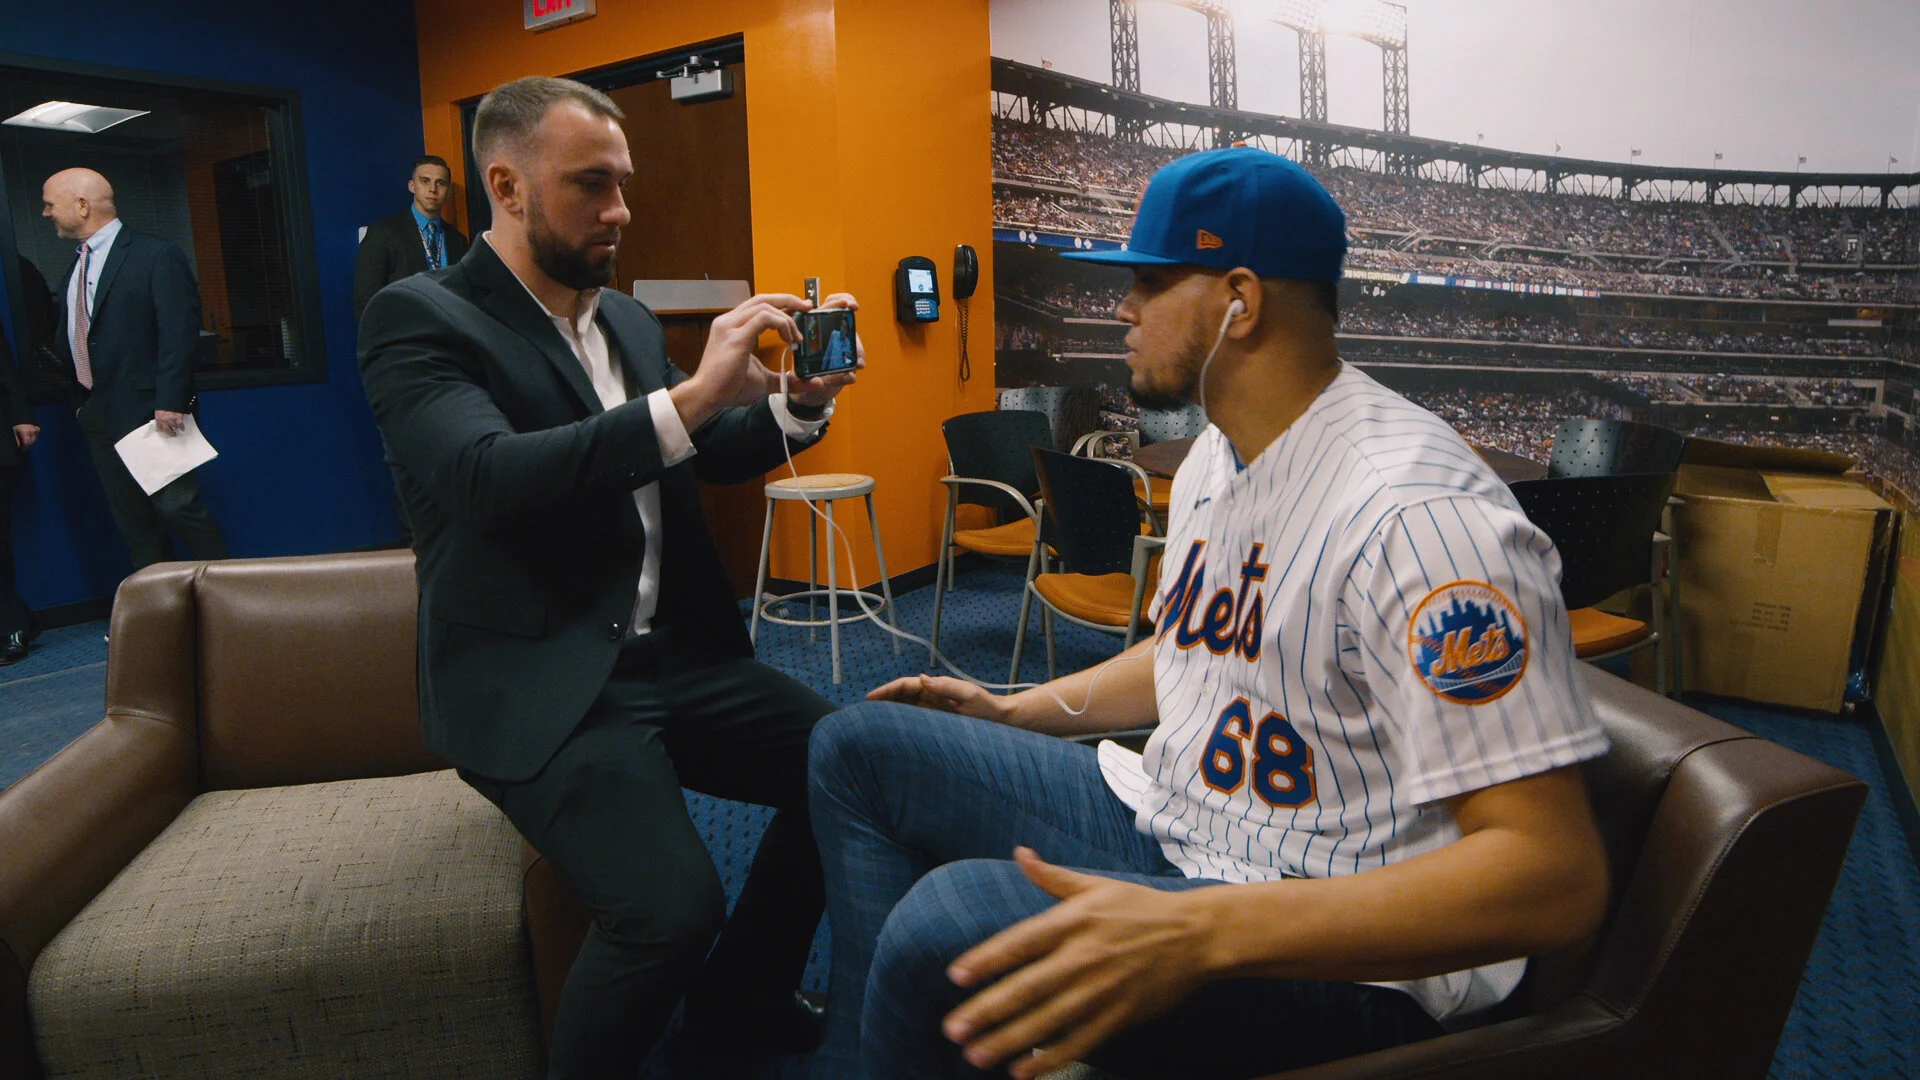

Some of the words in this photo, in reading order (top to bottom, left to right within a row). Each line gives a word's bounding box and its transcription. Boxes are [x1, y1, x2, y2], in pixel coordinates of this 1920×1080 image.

[1156, 539, 1270, 663] Mets
[1430, 623, 1511, 677] Mets
[1199, 696, 1317, 809] 68
